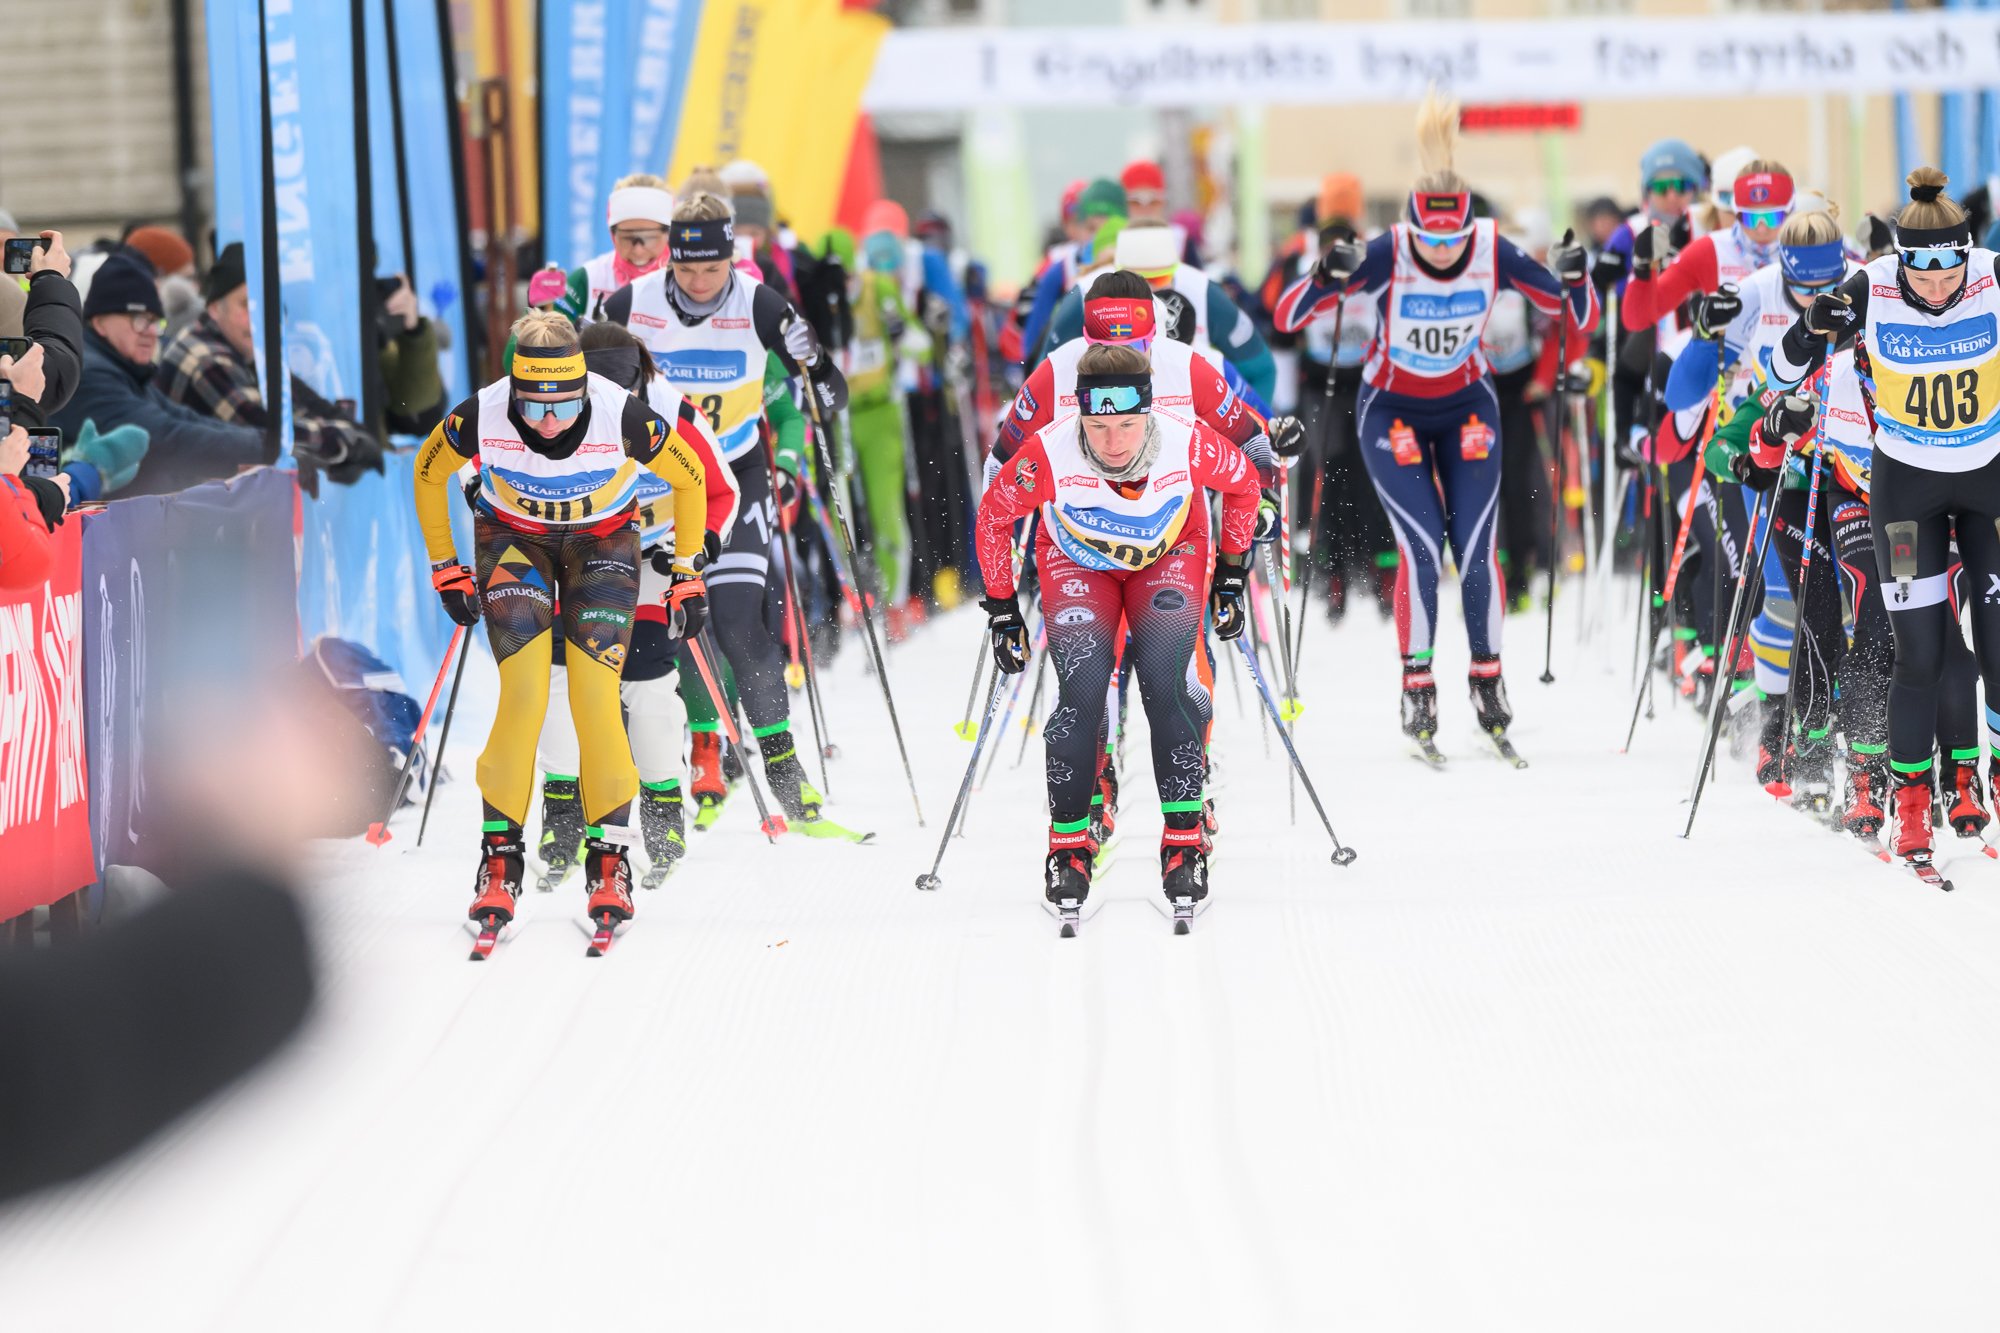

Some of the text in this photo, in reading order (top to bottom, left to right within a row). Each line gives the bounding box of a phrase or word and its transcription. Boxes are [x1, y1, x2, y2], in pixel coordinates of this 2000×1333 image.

[1892, 335, 1992, 358] AB KARL HEDIN
[530, 364, 576, 374] Ramudden
[663, 367, 738, 379] KARL HEDIN
[1905, 368, 1979, 430] 403
[527, 482, 565, 496] KARL
[1076, 513, 1099, 527] AB
[1101, 522, 1139, 536] KARL
[1786, 524, 1832, 562] TRITEX
[1051, 835, 1087, 844] MADSHUS
[1165, 833, 1200, 841] MADSHUS
